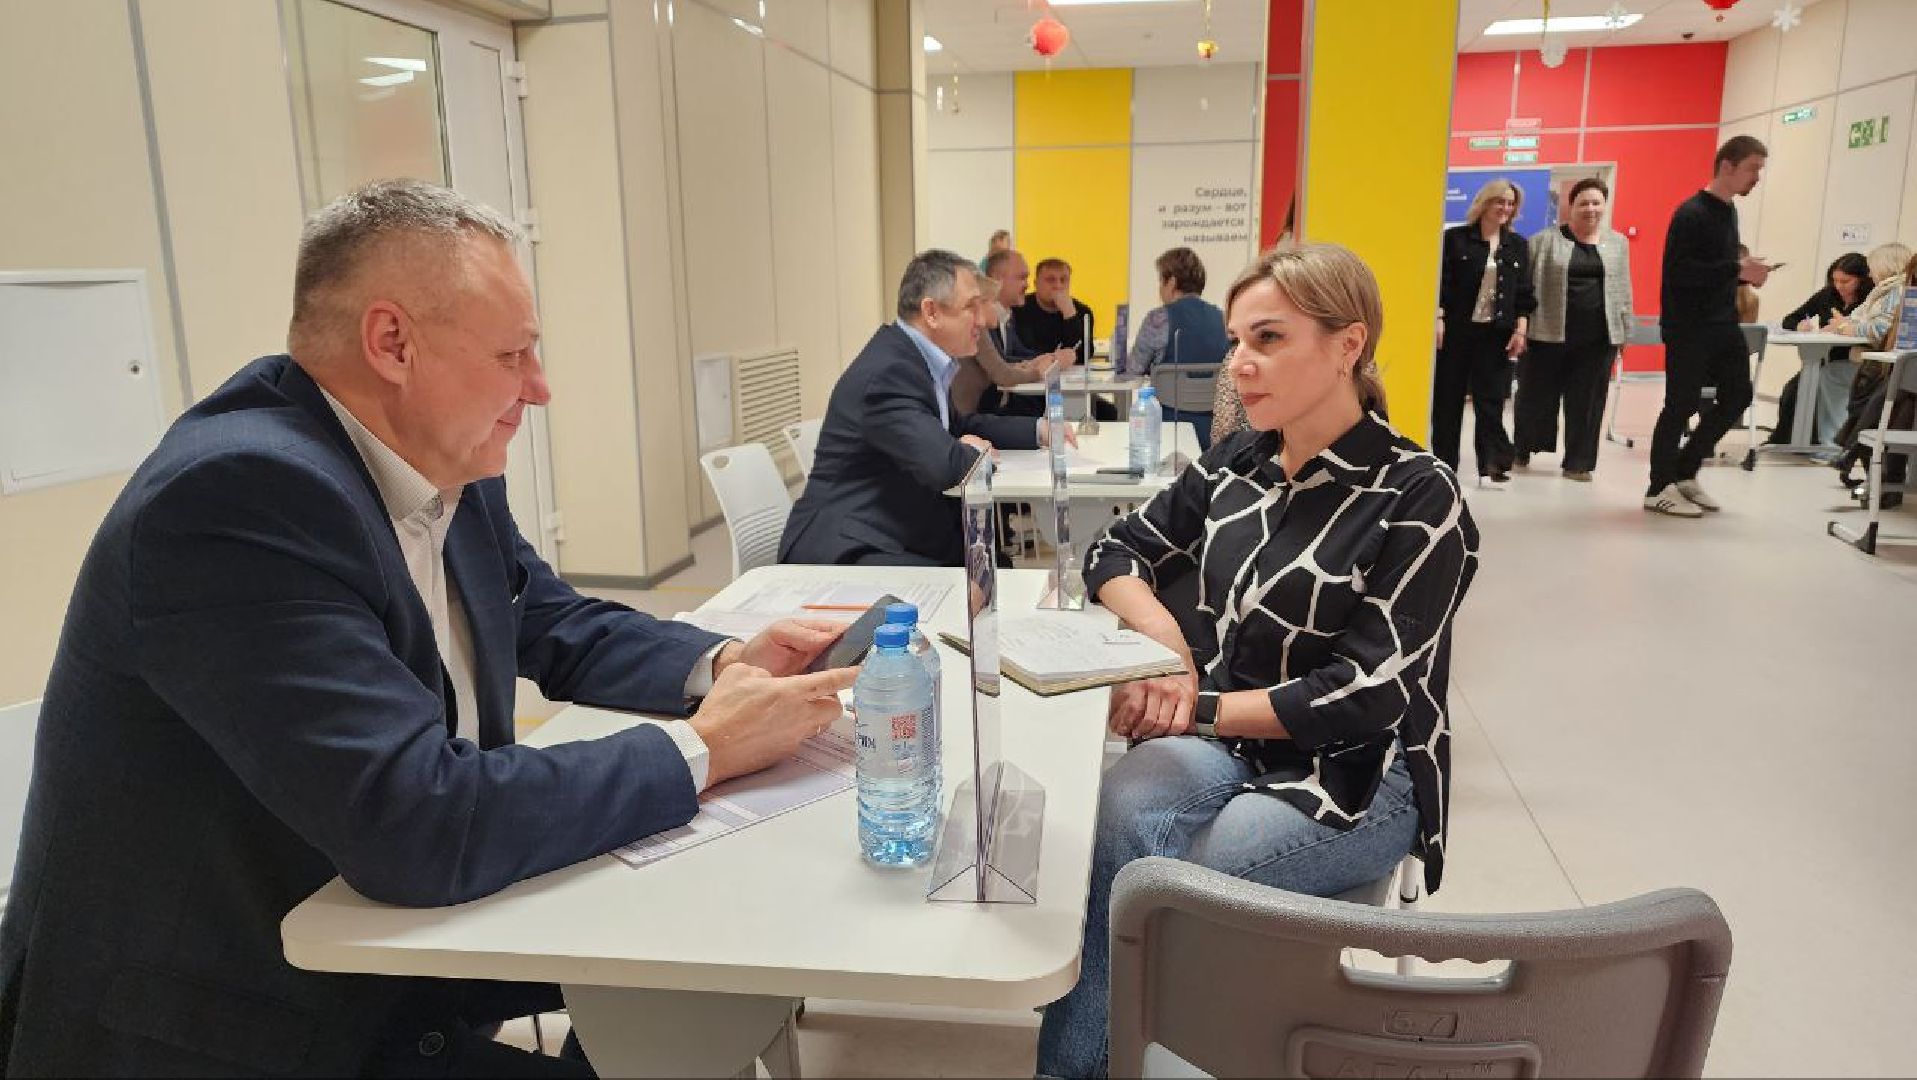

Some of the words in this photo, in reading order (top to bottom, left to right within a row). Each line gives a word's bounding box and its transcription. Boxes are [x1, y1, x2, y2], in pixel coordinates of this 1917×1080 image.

[1173, 204, 1211, 214] разум
[1225, 202, 1246, 211] вот
[1162, 218, 1244, 230] зарождается
[1183, 233, 1247, 242] называем
